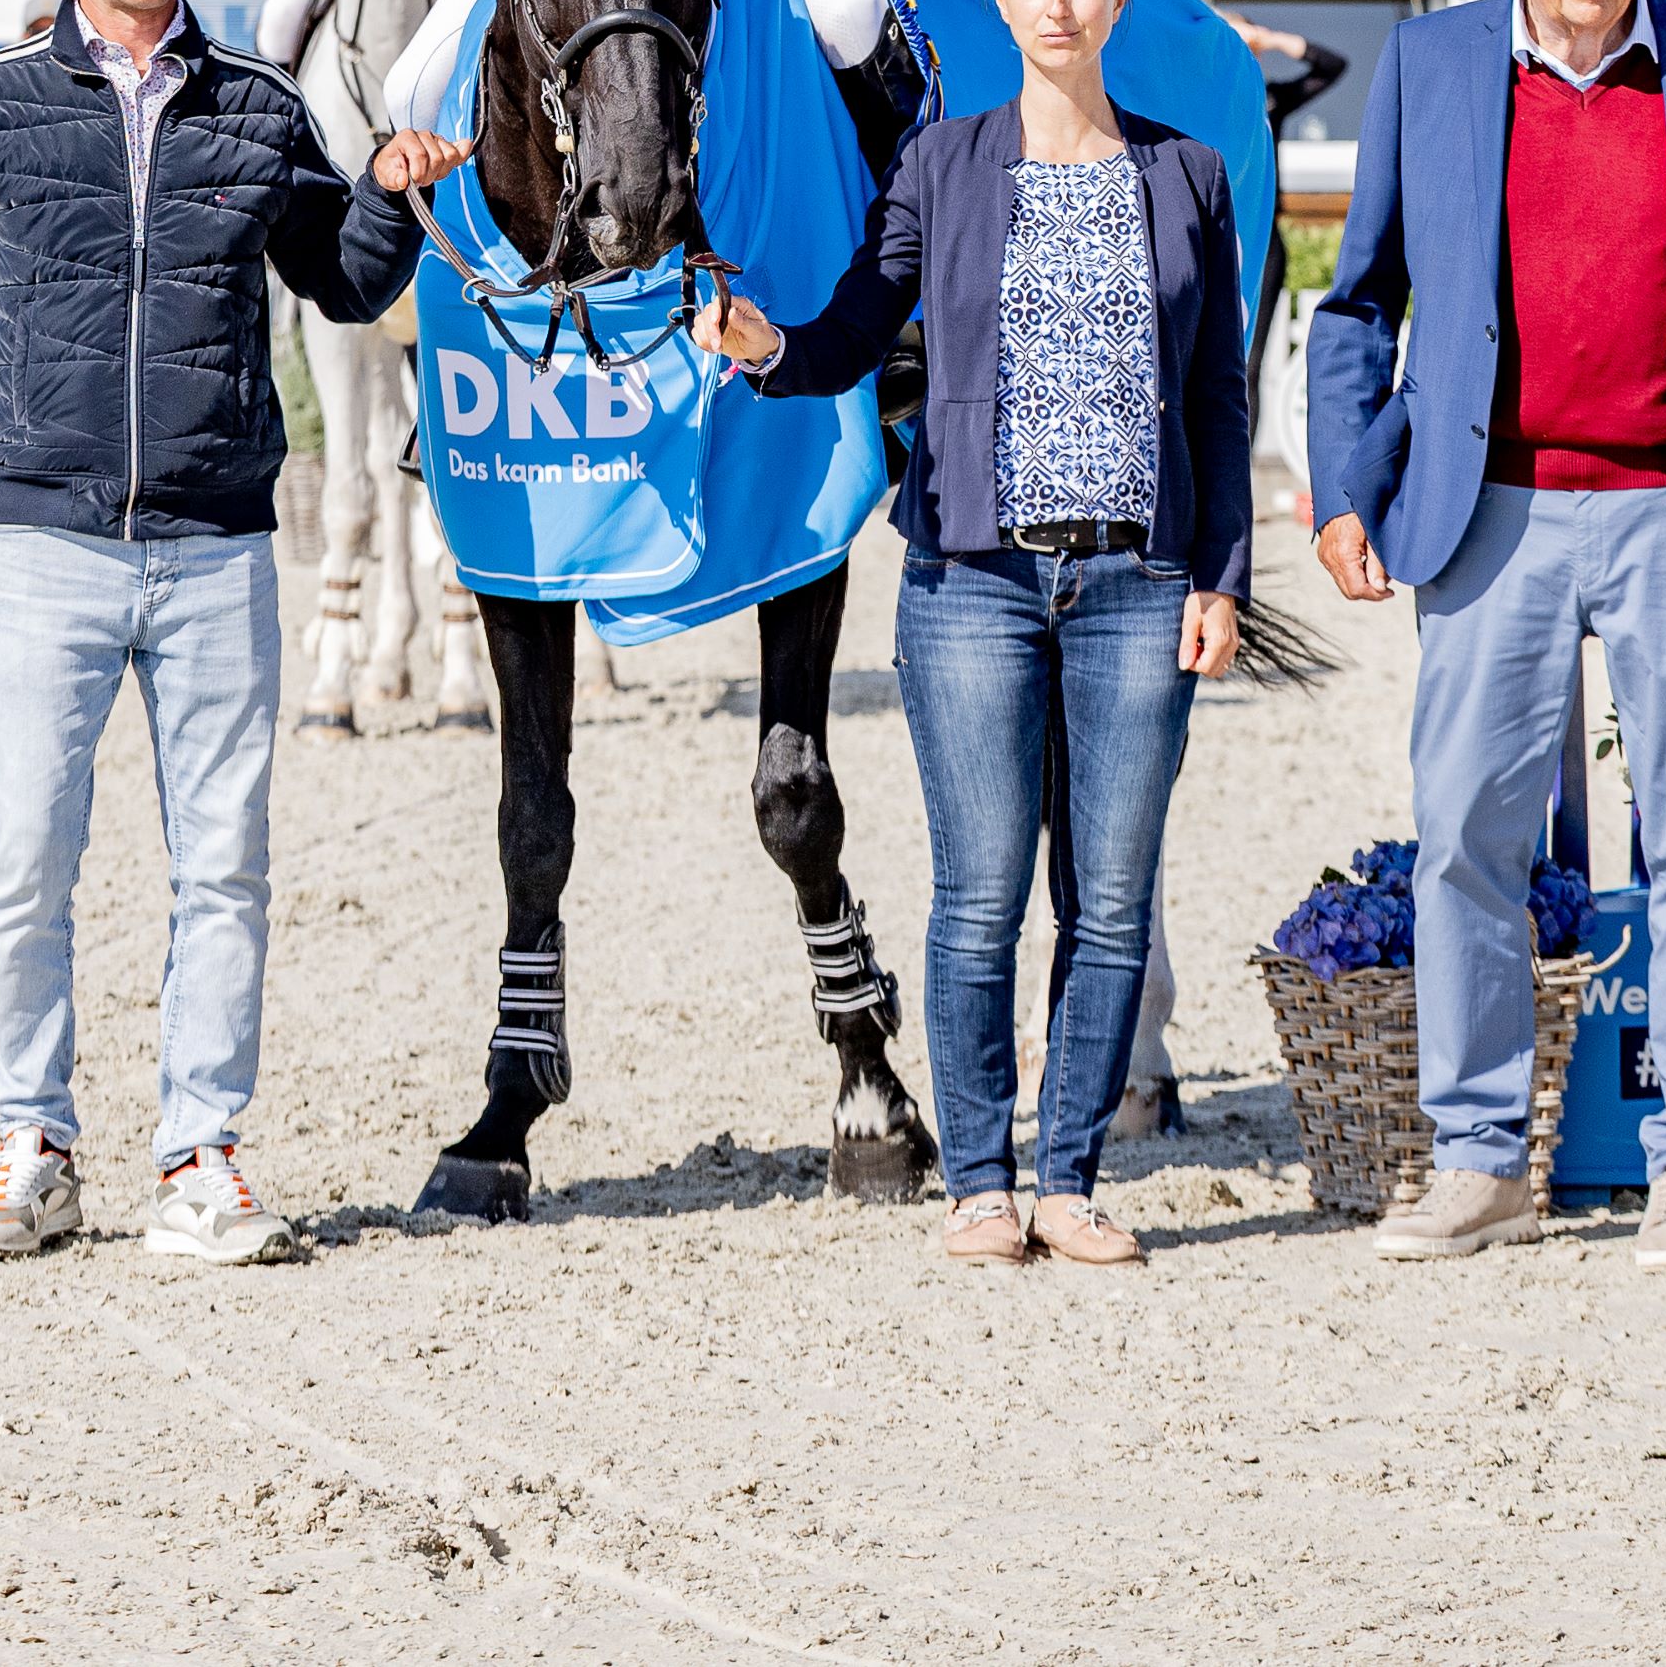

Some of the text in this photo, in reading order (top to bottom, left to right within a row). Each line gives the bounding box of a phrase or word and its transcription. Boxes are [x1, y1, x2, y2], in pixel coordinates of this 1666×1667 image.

[436, 345, 655, 440] DKB
[448, 448, 647, 484] Das kann Bank
